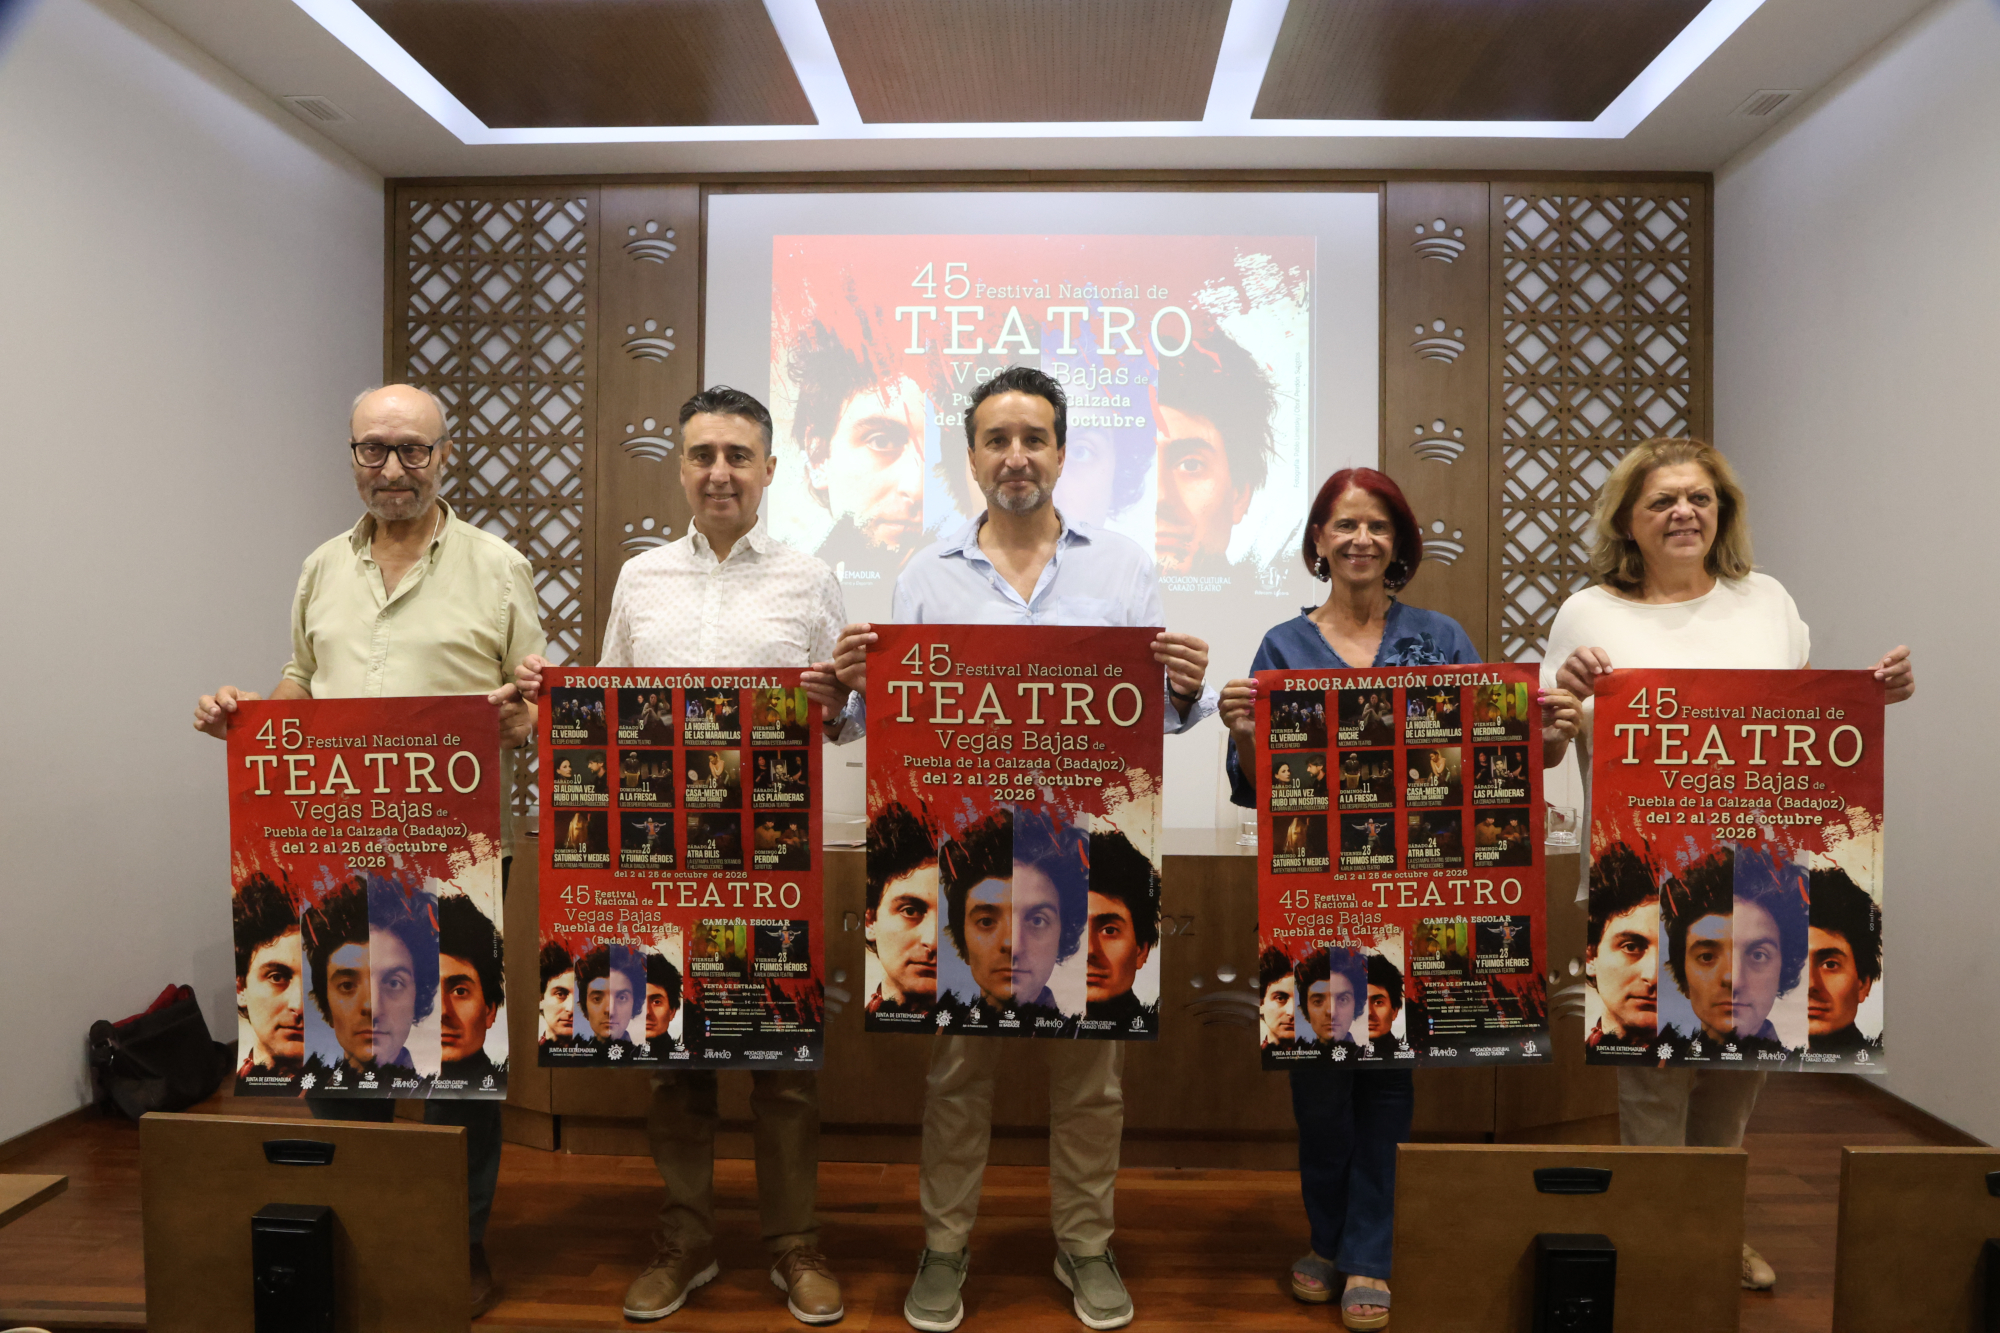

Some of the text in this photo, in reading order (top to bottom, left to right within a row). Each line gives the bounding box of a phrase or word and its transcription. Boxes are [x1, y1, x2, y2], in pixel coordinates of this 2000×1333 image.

[911, 262, 1168, 299] 45 Festival Nacional de
[895, 306, 1192, 357] TEATRO
[1051, 362, 1129, 391] Bajas
[1134, 375, 1149, 385] de
[1067, 395, 1130, 407] Calzada
[934, 413, 964, 426] del
[1070, 414, 1145, 428] octubre
[901, 643, 1122, 677] 45 Festival Nacional de
[564, 673, 782, 689] PROGRAMACIÓN OFICIAL
[1284, 673, 1502, 691] PROGRAMACIÓN OFICIAL
[888, 681, 1143, 727] TEATRO
[1628, 687, 1844, 720] 45 Festival Nacional de
[256, 719, 460, 749] 45 Festival Nacional de
[552, 730, 588, 738] EL VERDUGO
[685, 731, 740, 739] DE LAS MARAVILLAS
[752, 731, 784, 739] VIERDINGO
[935, 729, 1105, 755] Vegas Bajas de
[1614, 724, 1863, 767] TEATRO
[903, 756, 1125, 772] Puebla de la Calzada (Badajoz)
[245, 751, 481, 795] TEATRO
[922, 773, 947, 785] del
[953, 774, 962, 785] 2
[967, 774, 982, 785] al
[1014, 774, 1032, 786] de
[1038, 775, 1102, 786] octubre
[1660, 770, 1825, 794] Vegas Bajas de
[554, 785, 595, 793] SI ALGUNA VEZ
[686, 789, 727, 797] CASA-MIENTO
[994, 789, 1035, 800] 2026
[620, 793, 657, 801] A LA FRESCA
[1628, 796, 1845, 811] Puebla de la Calzada (Badajoz)
[291, 800, 447, 823] Vegas Bajas de
[1646, 812, 1671, 824] del
[1676, 813, 1685, 824] 2
[1690, 813, 1704, 824] al
[1736, 813, 1754, 825] de
[1759, 814, 1822, 825] octubre
[264, 823, 468, 838] Puebla de la Calzada (Badajoz)
[1716, 827, 1756, 839] 2026
[282, 842, 304, 853] del
[310, 843, 318, 853] 2
[323, 842, 336, 853] al
[366, 842, 383, 852] de
[388, 841, 447, 852] octubre
[554, 854, 609, 862] SATURNOS Y MEDEAS
[650, 853, 673, 863] HÉROES
[687, 850, 719, 858] ATRA BILIS
[755, 854, 779, 863] PERDÓN
[348, 856, 386, 868] 2026
[560, 885, 590, 905] 45
[595, 890, 635, 899] Festival
[652, 882, 801, 908] TEATRO
[1279, 889, 1310, 909] 45
[1314, 893, 1355, 902] Festival
[1372, 878, 1522, 908] TEATRO
[595, 898, 639, 906] Nacional
[1314, 900, 1373, 909] Nacional de
[565, 909, 661, 925] Vegas Bajas
[702, 917, 747, 926] CAMPAÑA
[1284, 911, 1381, 928] Vegas Bajas
[1423, 915, 1511, 924] CAMPAÑA ESCOLAR
[554, 923, 679, 934] Puebla de la Calzada
[1273, 925, 1400, 937] Puebla de la Calzada
[592, 935, 641, 946] (Badajoz)
[1312, 938, 1361, 948] (Badajoz)
